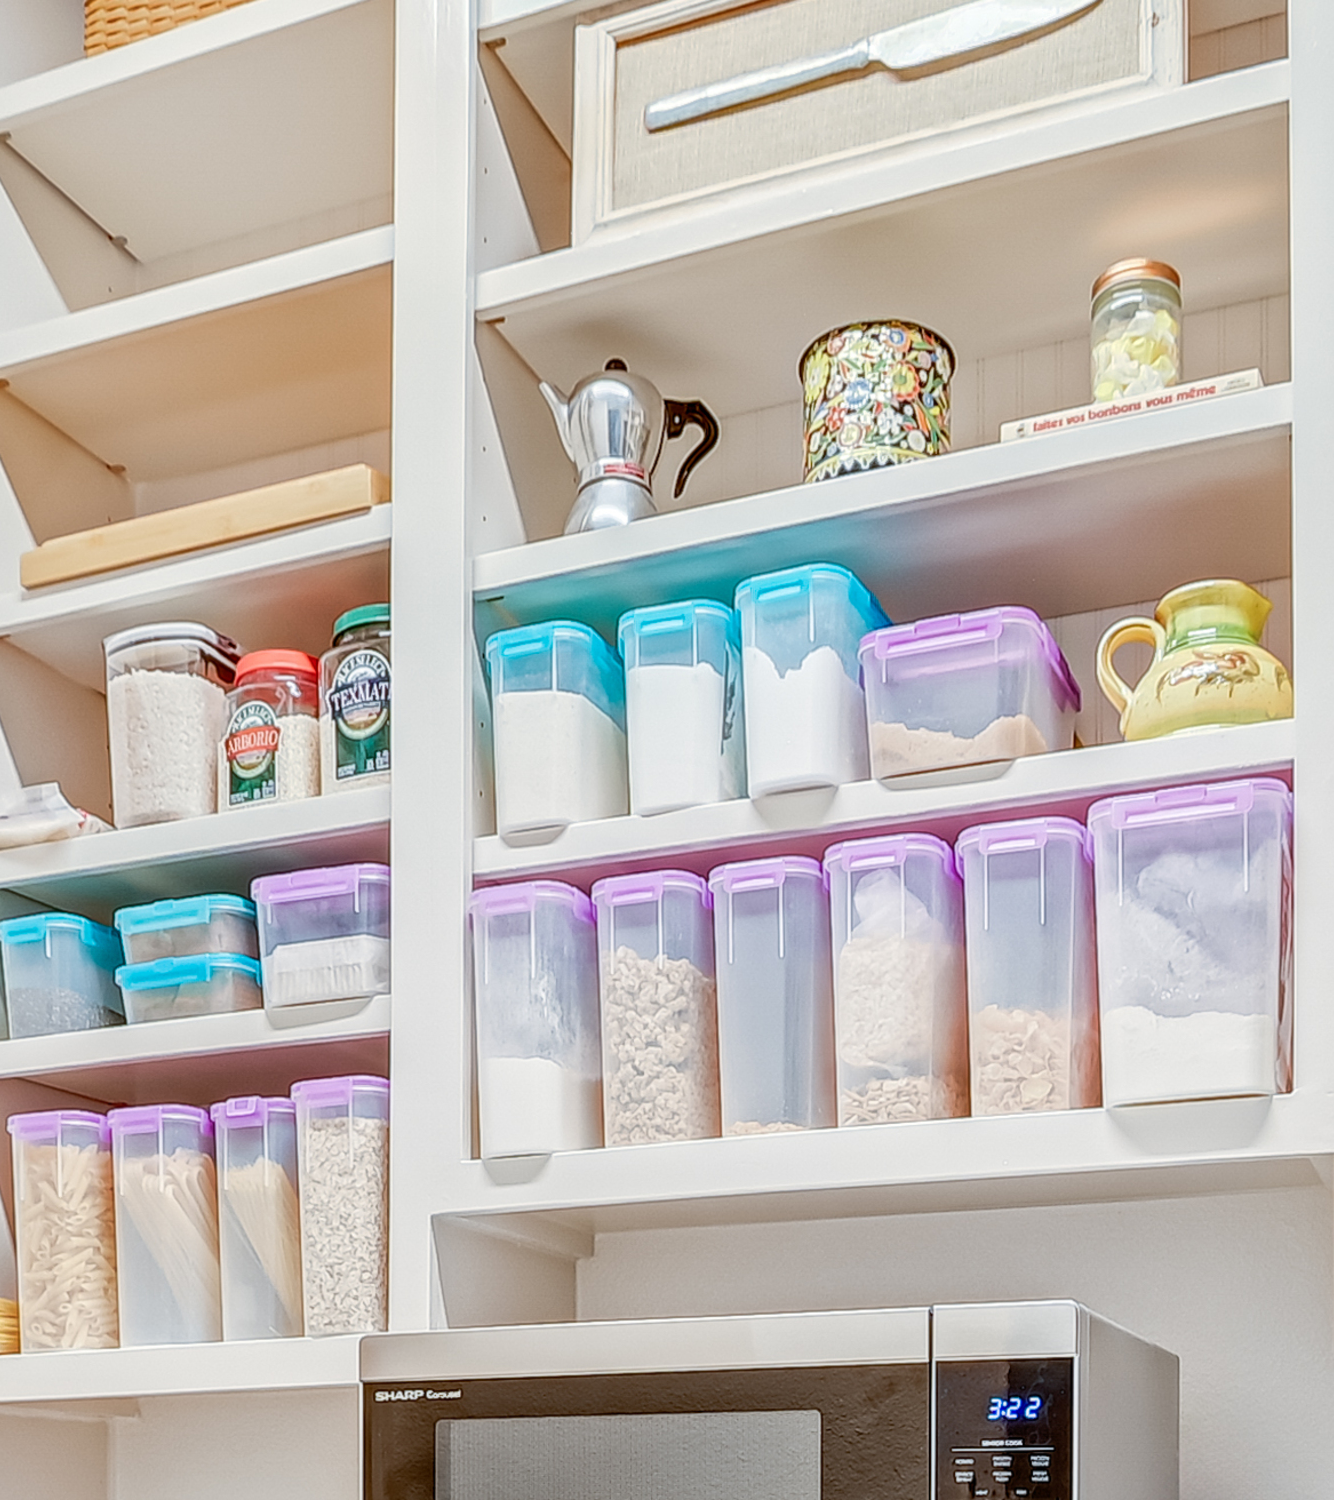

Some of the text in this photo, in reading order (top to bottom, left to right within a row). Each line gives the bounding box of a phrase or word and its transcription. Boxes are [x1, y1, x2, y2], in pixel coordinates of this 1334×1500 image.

[1032, 418, 1064, 433] faites
[1066, 414, 1086, 426] vos
[1088, 401, 1142, 421] bonbons
[1145, 394, 1174, 409] vous
[1176, 384, 1217, 402] même
[227, 729, 279, 756] ARBORIO
[374, 1390, 424, 1402] SHARP
[987, 1396, 1042, 1420] 3:22
